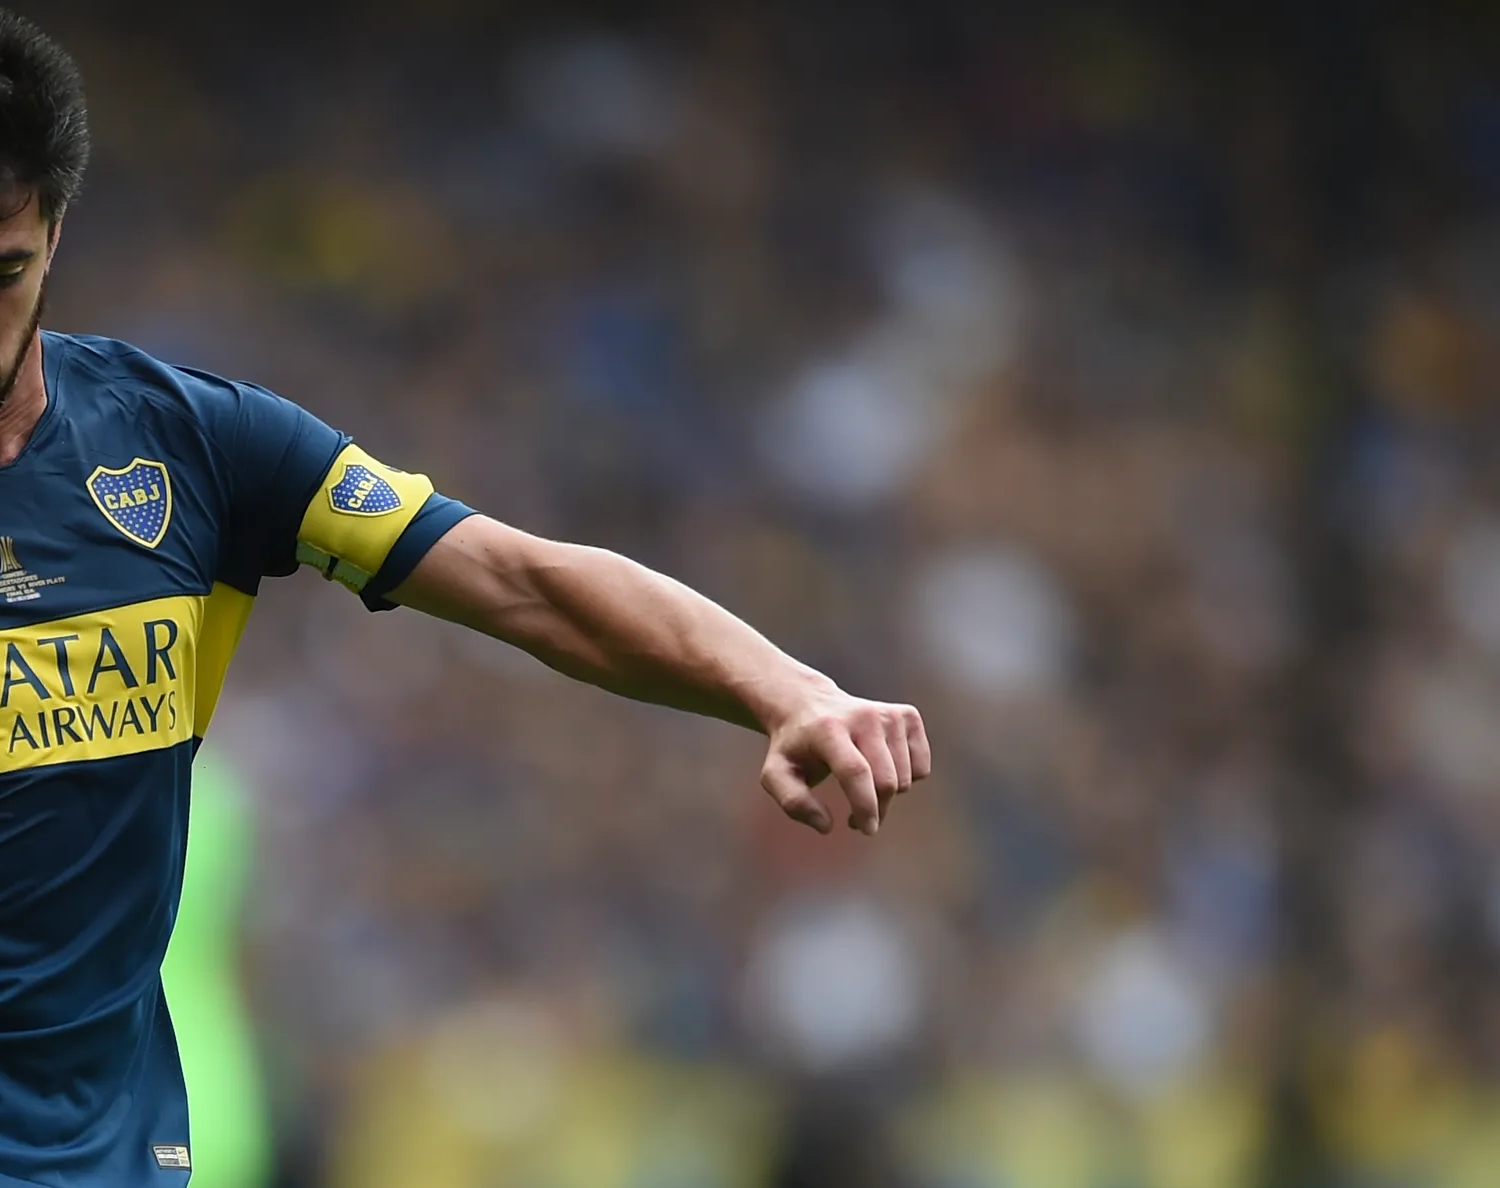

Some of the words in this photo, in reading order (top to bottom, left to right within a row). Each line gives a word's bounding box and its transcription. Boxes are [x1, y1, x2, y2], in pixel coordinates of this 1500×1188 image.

[104, 484, 160, 509] CABJ
[348, 473, 377, 508] CABJ
[28, 580, 46, 588] RIVER
[46, 576, 66, 585] PLATE
[9, 690, 176, 753] AIRWAYS
